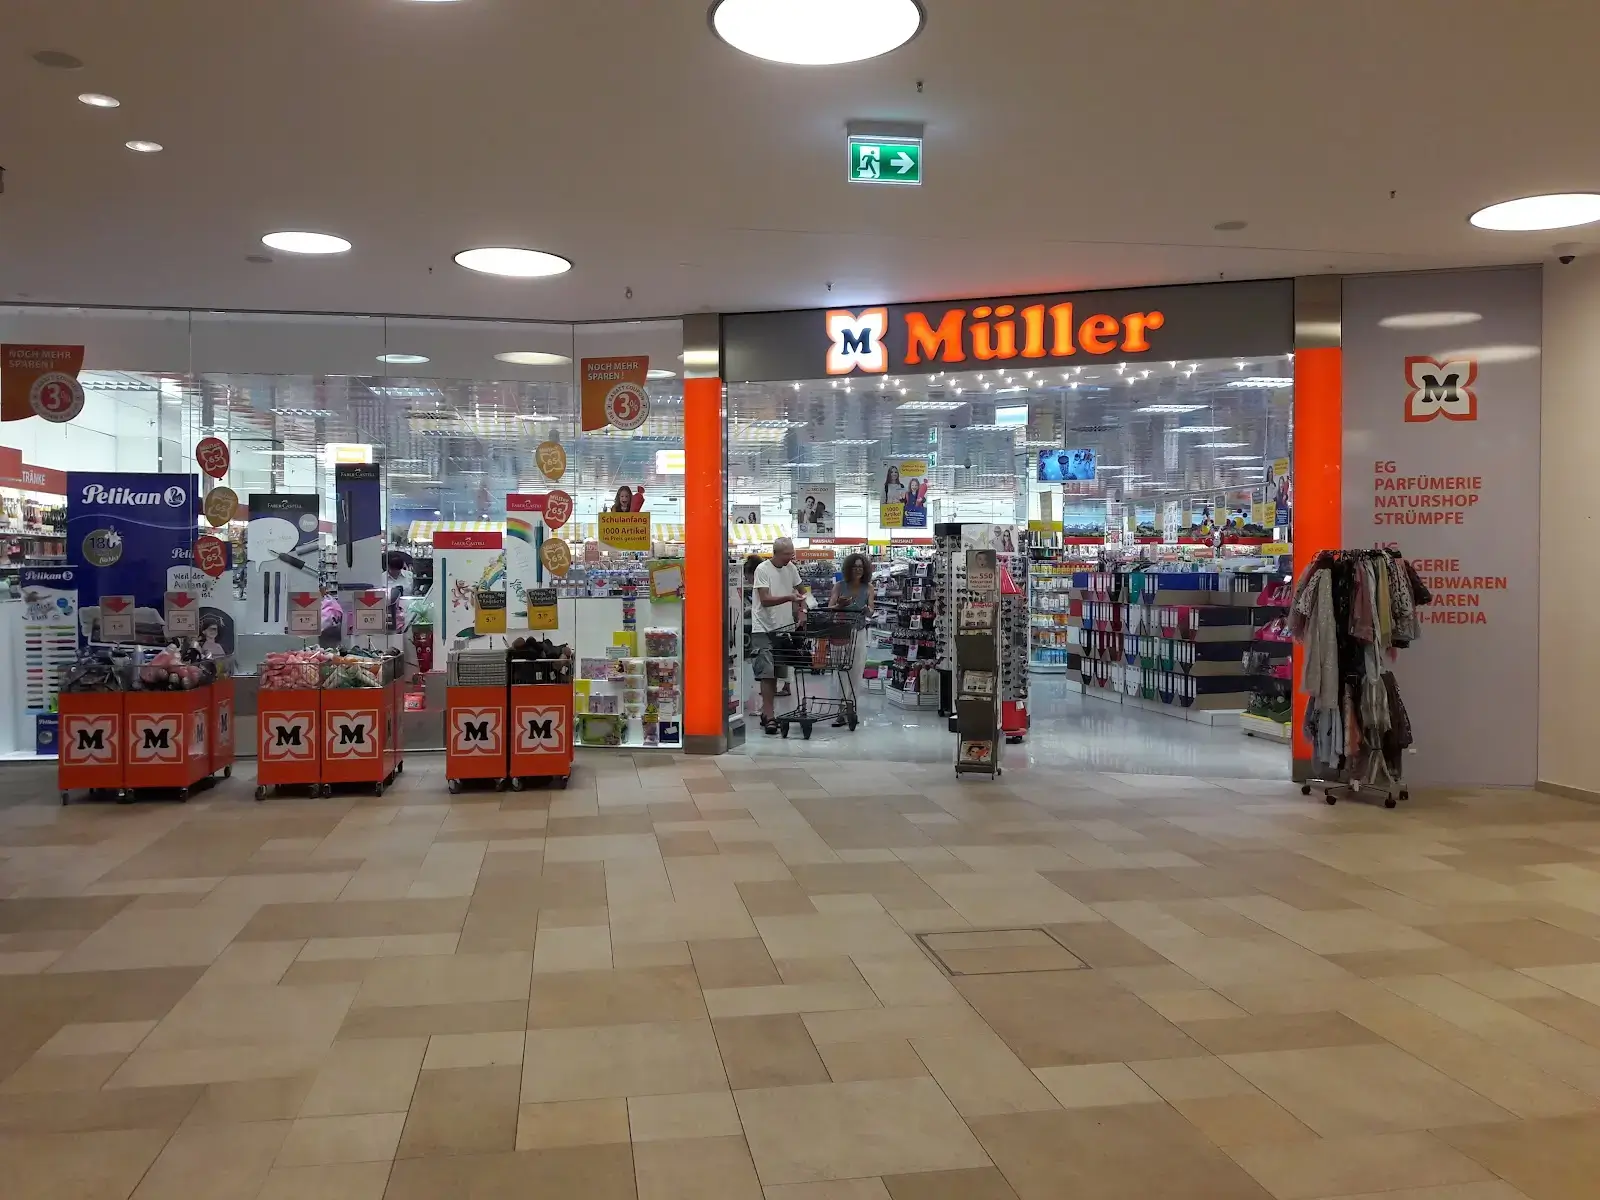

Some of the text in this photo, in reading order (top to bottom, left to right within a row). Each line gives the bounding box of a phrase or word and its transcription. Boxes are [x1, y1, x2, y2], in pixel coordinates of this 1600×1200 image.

[841, 327, 874, 356] M
[904, 302, 1165, 366] Müller
[9, 350, 72, 359] NOCH MEHR
[588, 361, 639, 371] NOCH MEHR
[1421, 373, 1460, 403] M
[618, 392, 639, 418] 3%
[1374, 460, 1397, 473] EG
[22, 470, 46, 486] TRÄNKE
[1374, 475, 1482, 490] PARFÜMERIE
[82, 484, 161, 506] Pelikan
[1374, 494, 1479, 508] NATURSHOP
[551, 506, 563, 515] 65
[1374, 510, 1464, 525] STRÜMPFE
[601, 516, 648, 525] Schulanfang
[206, 554, 218, 562] 65
[551, 555, 563, 563] 65
[1410, 559, 1460, 572] GERIE
[25, 570, 62, 581] Pelikan
[979, 572, 994, 580] 550
[1419, 576, 1507, 590] EIBWAREN
[1421, 611, 1488, 625] I-MEDIA
[275, 725, 302, 747] M
[339, 724, 365, 746] M
[464, 721, 489, 742] M
[528, 719, 553, 740] M
[77, 729, 104, 750] M
[143, 728, 170, 749] M
